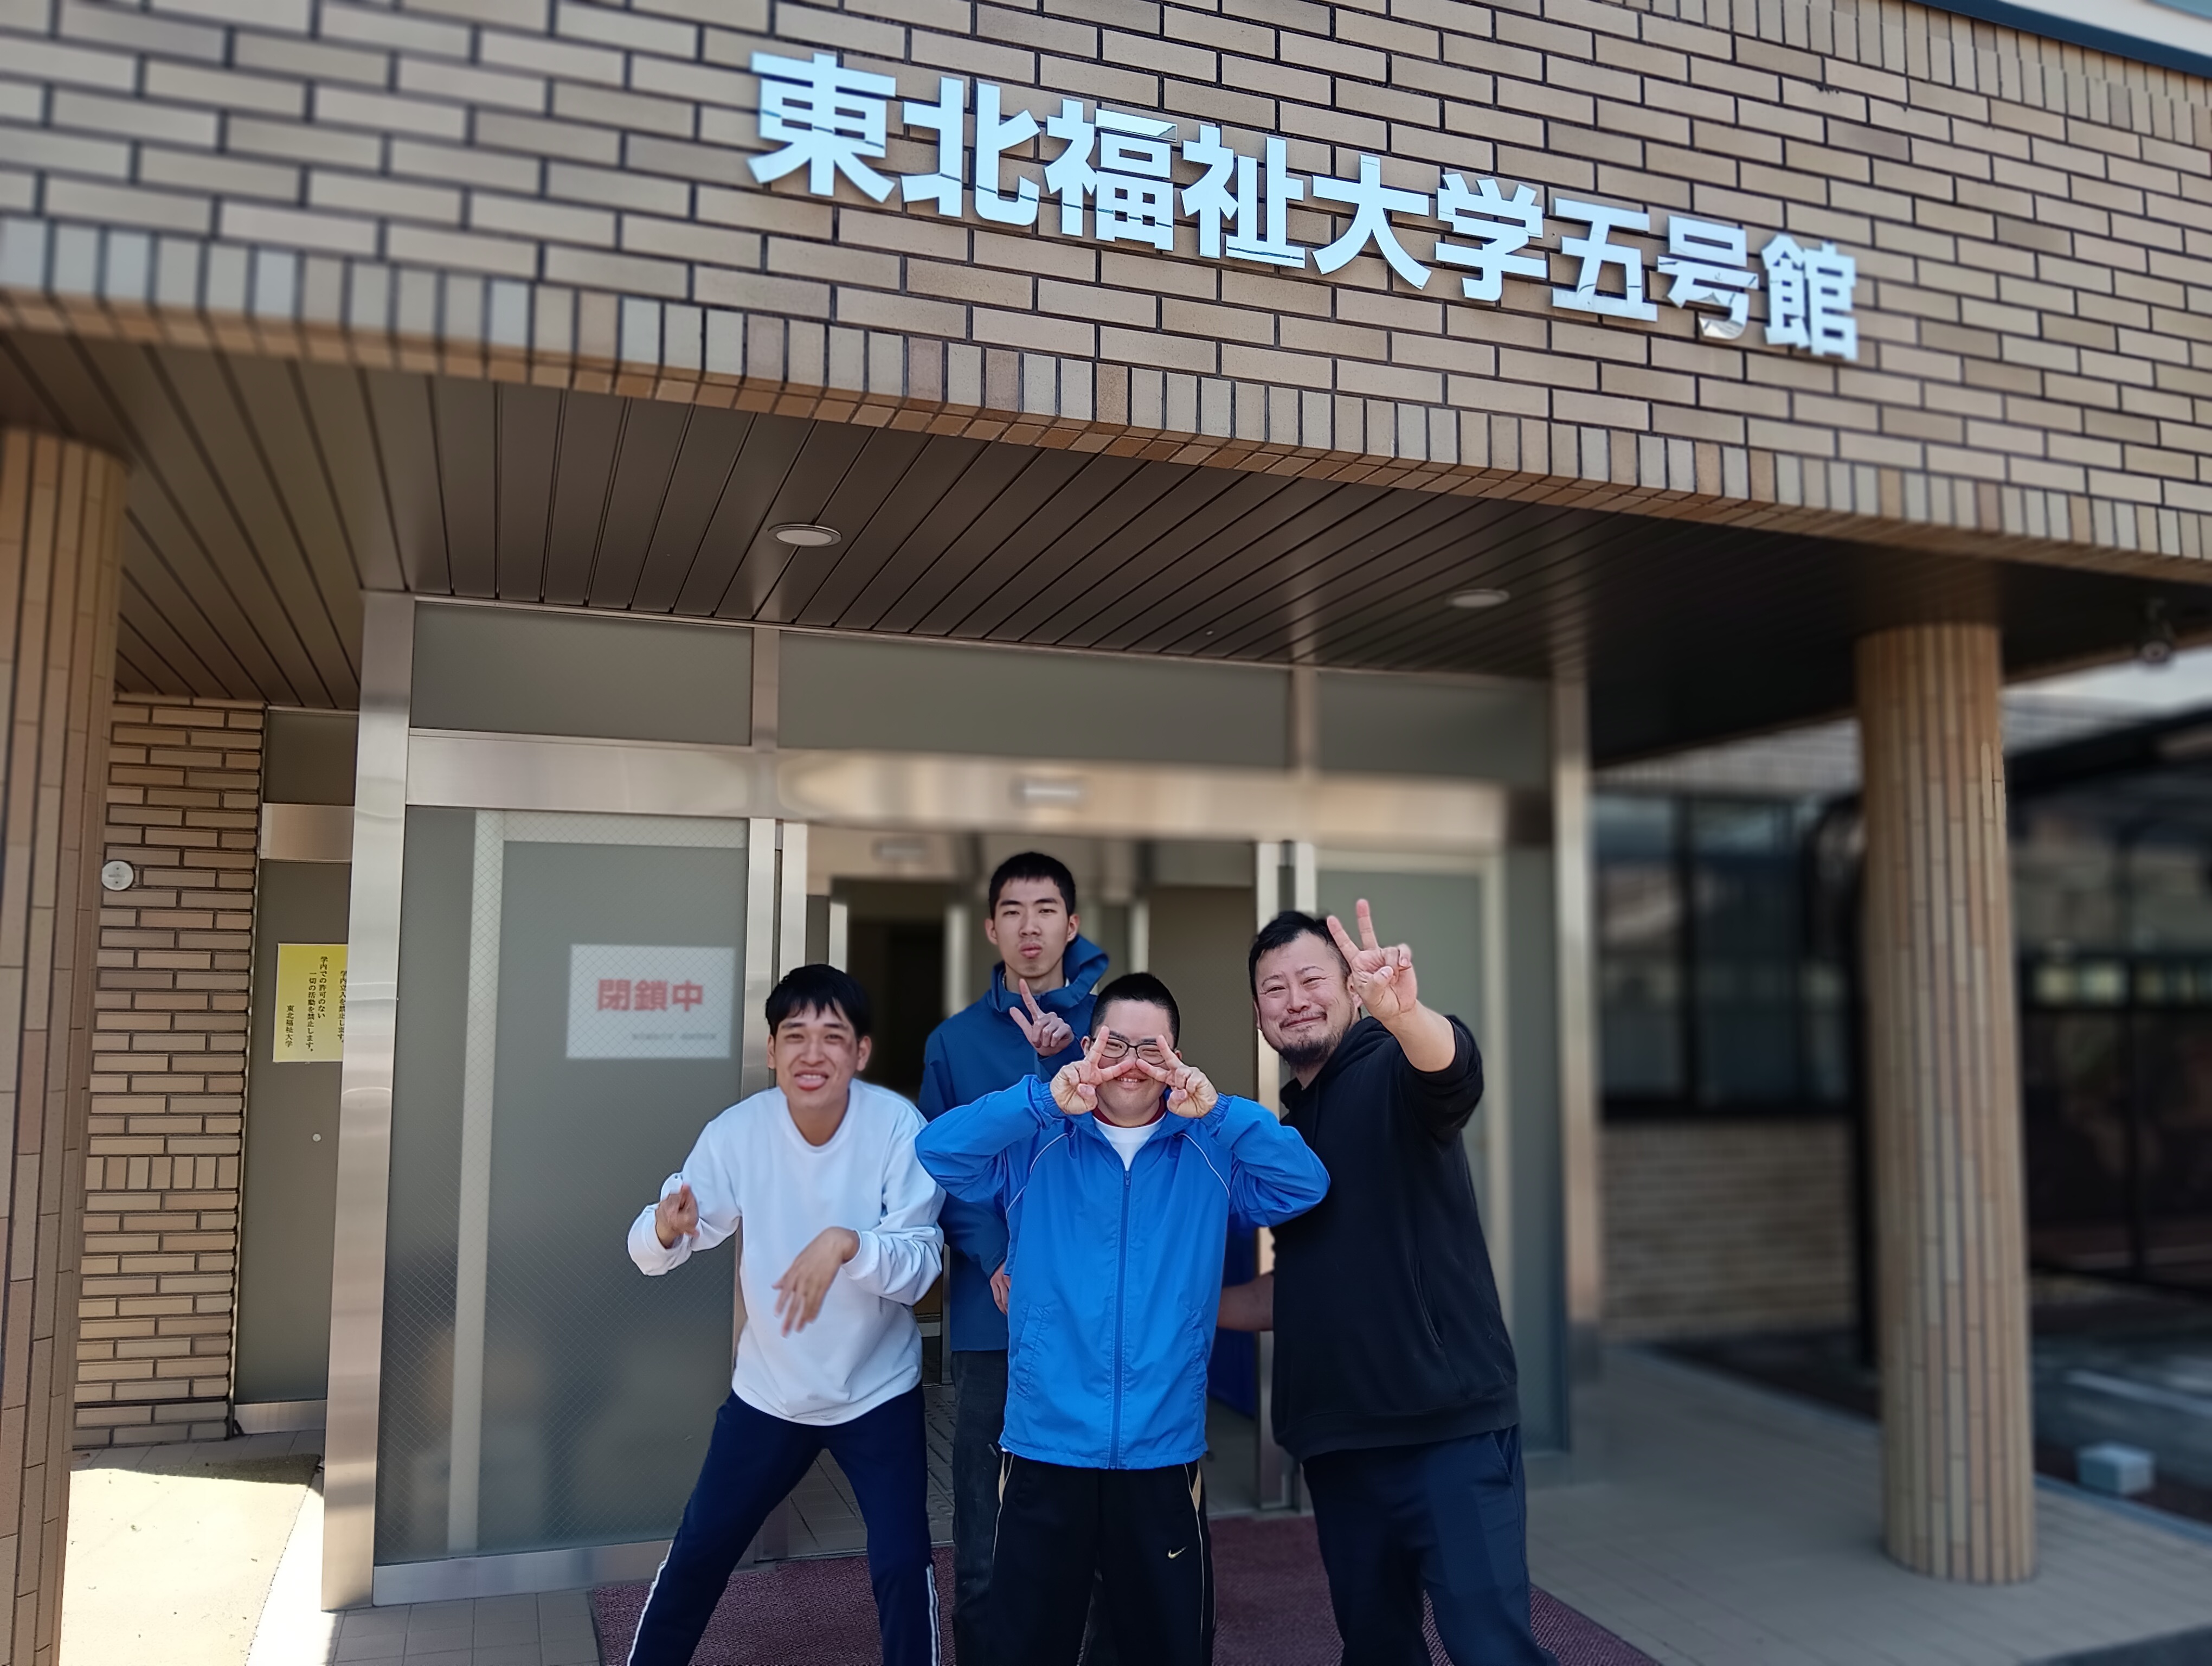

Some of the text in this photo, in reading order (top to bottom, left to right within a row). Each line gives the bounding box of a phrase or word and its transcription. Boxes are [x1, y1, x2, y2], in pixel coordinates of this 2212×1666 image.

[748, 50, 1861, 363] 東北福祉大学五号館
[597, 979, 703, 1012] 閉鎖中
[285, 1005, 294, 1047] 東北福祉大学
